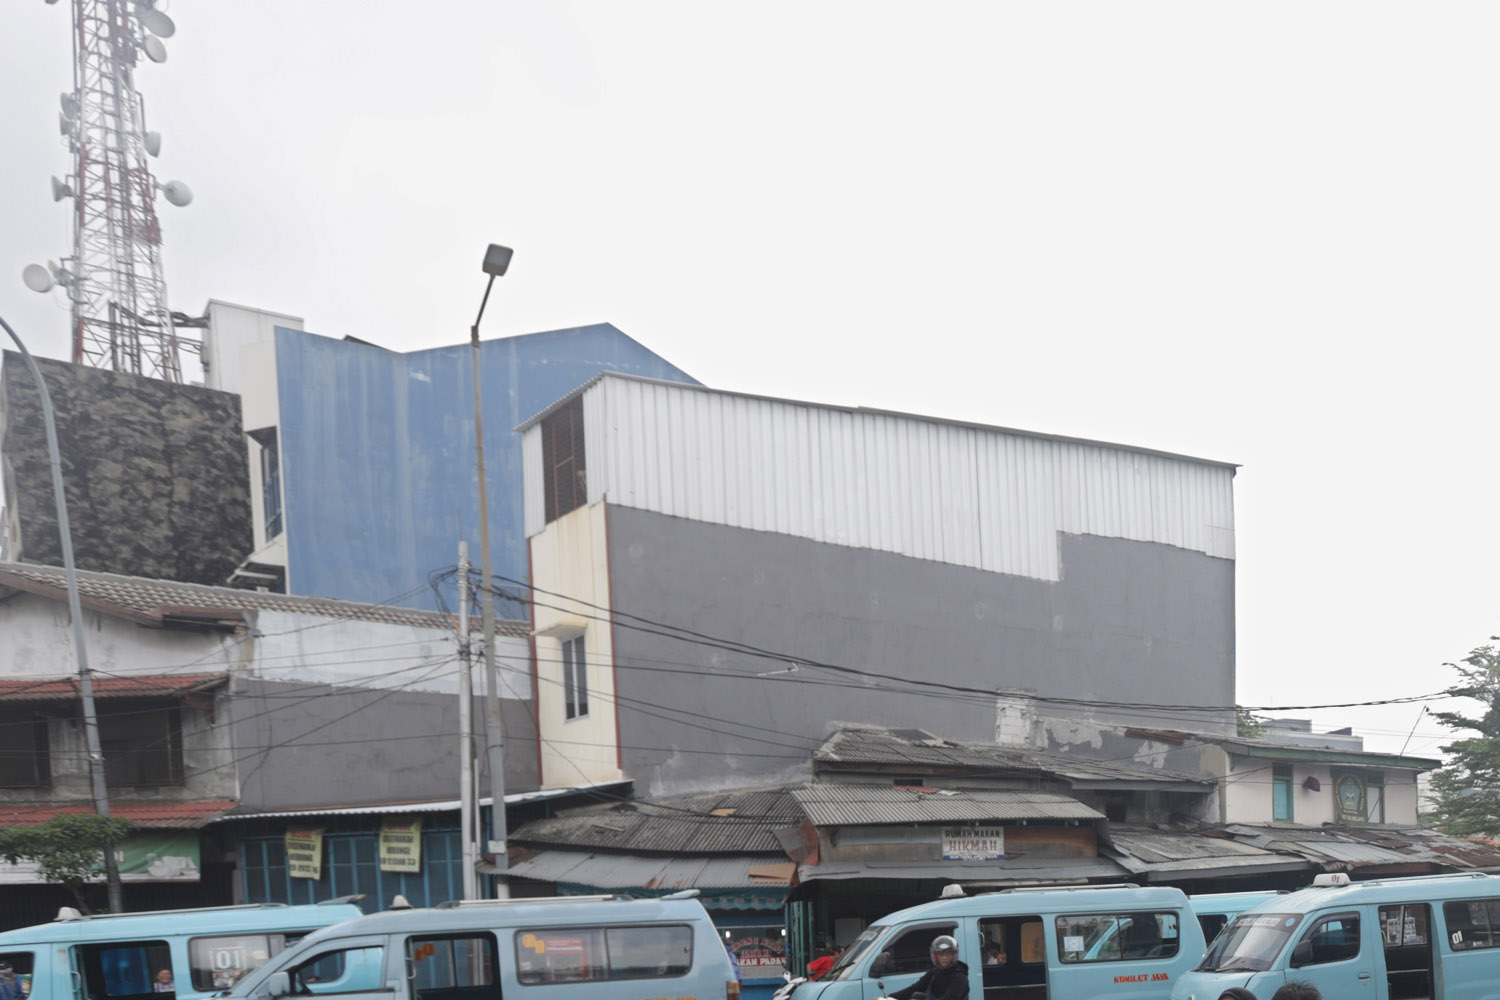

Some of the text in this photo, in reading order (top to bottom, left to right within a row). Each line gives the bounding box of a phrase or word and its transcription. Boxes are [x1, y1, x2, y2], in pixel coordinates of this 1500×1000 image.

[945, 830, 1000, 838] RUMAH MAKAN
[949, 840, 997, 851] HIKMAH
[1451, 930, 1463, 945] 01
[216, 950, 241, 969] 01
[737, 957, 758, 966] AKAN
